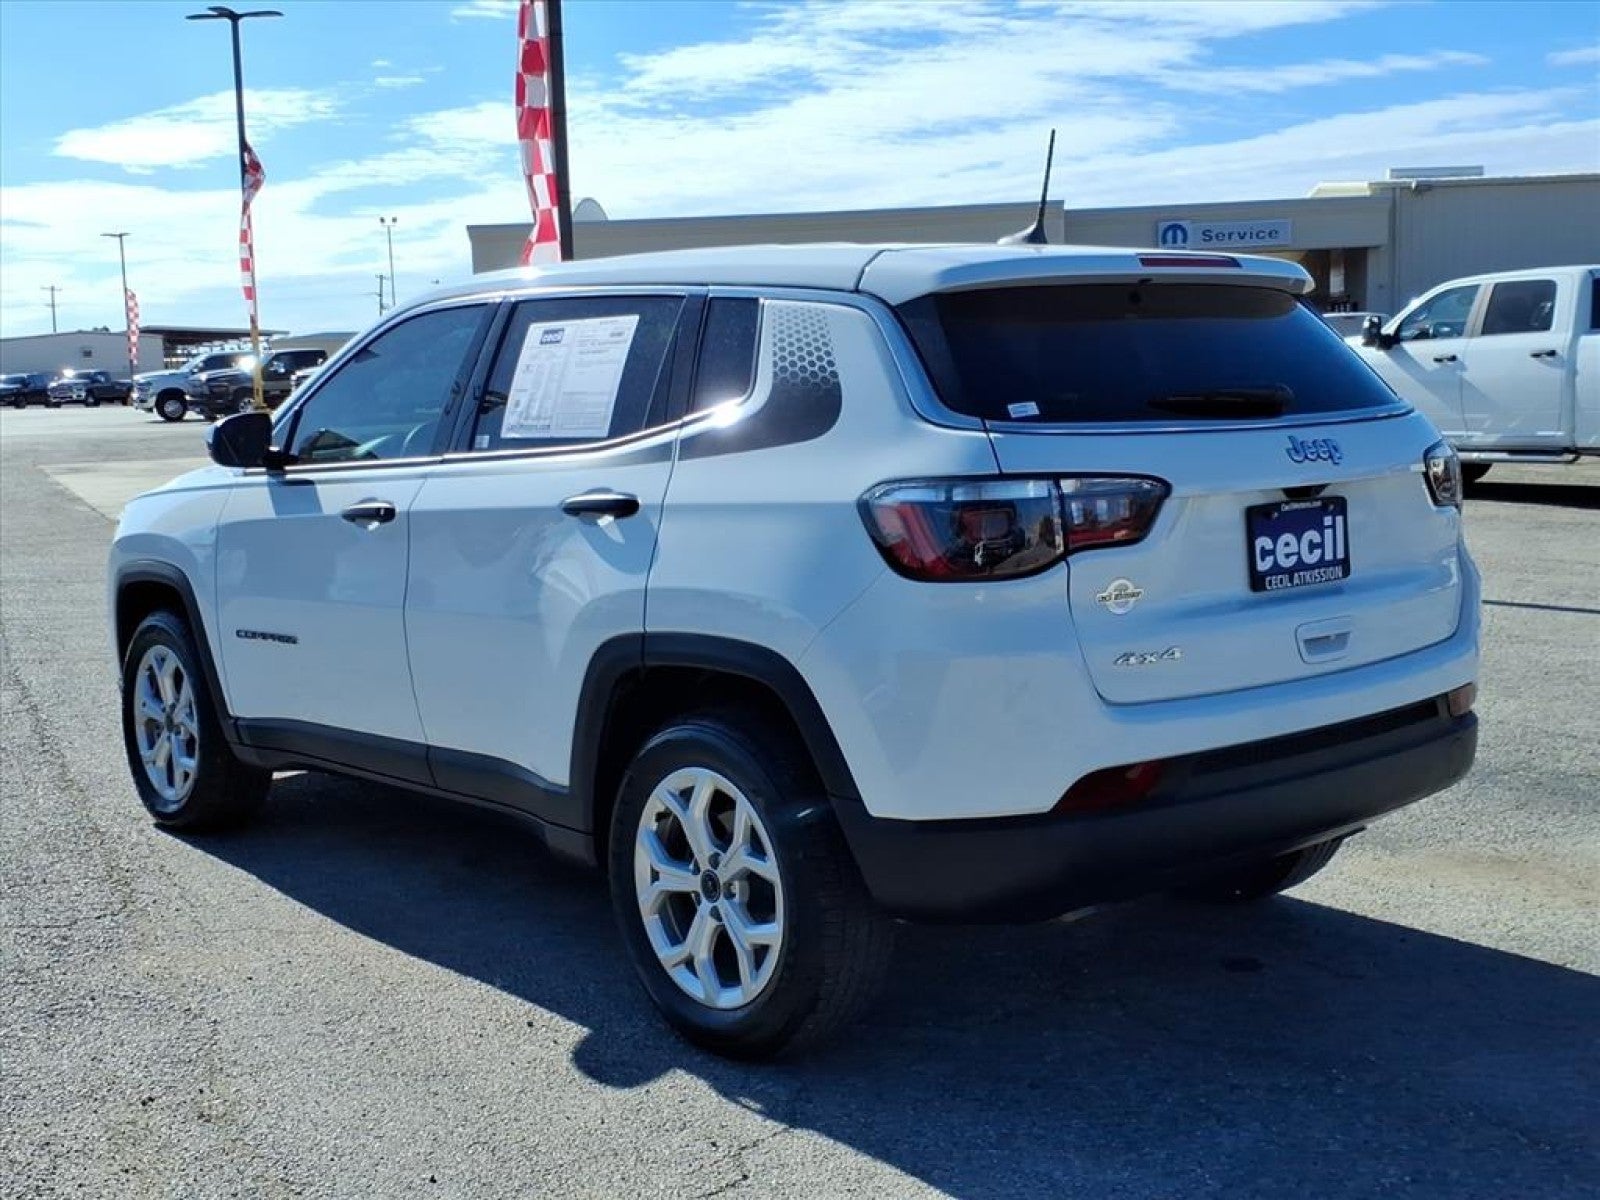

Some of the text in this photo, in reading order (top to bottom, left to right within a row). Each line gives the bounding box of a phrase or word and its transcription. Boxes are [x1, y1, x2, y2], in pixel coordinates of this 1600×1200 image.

[1201, 228, 1279, 242] Service
[1286, 435, 1343, 465] Jeep
[1255, 515, 1345, 572] cecil
[1265, 566, 1343, 590] CECIL ATKISSION
[1113, 645, 1182, 666] 4x4
